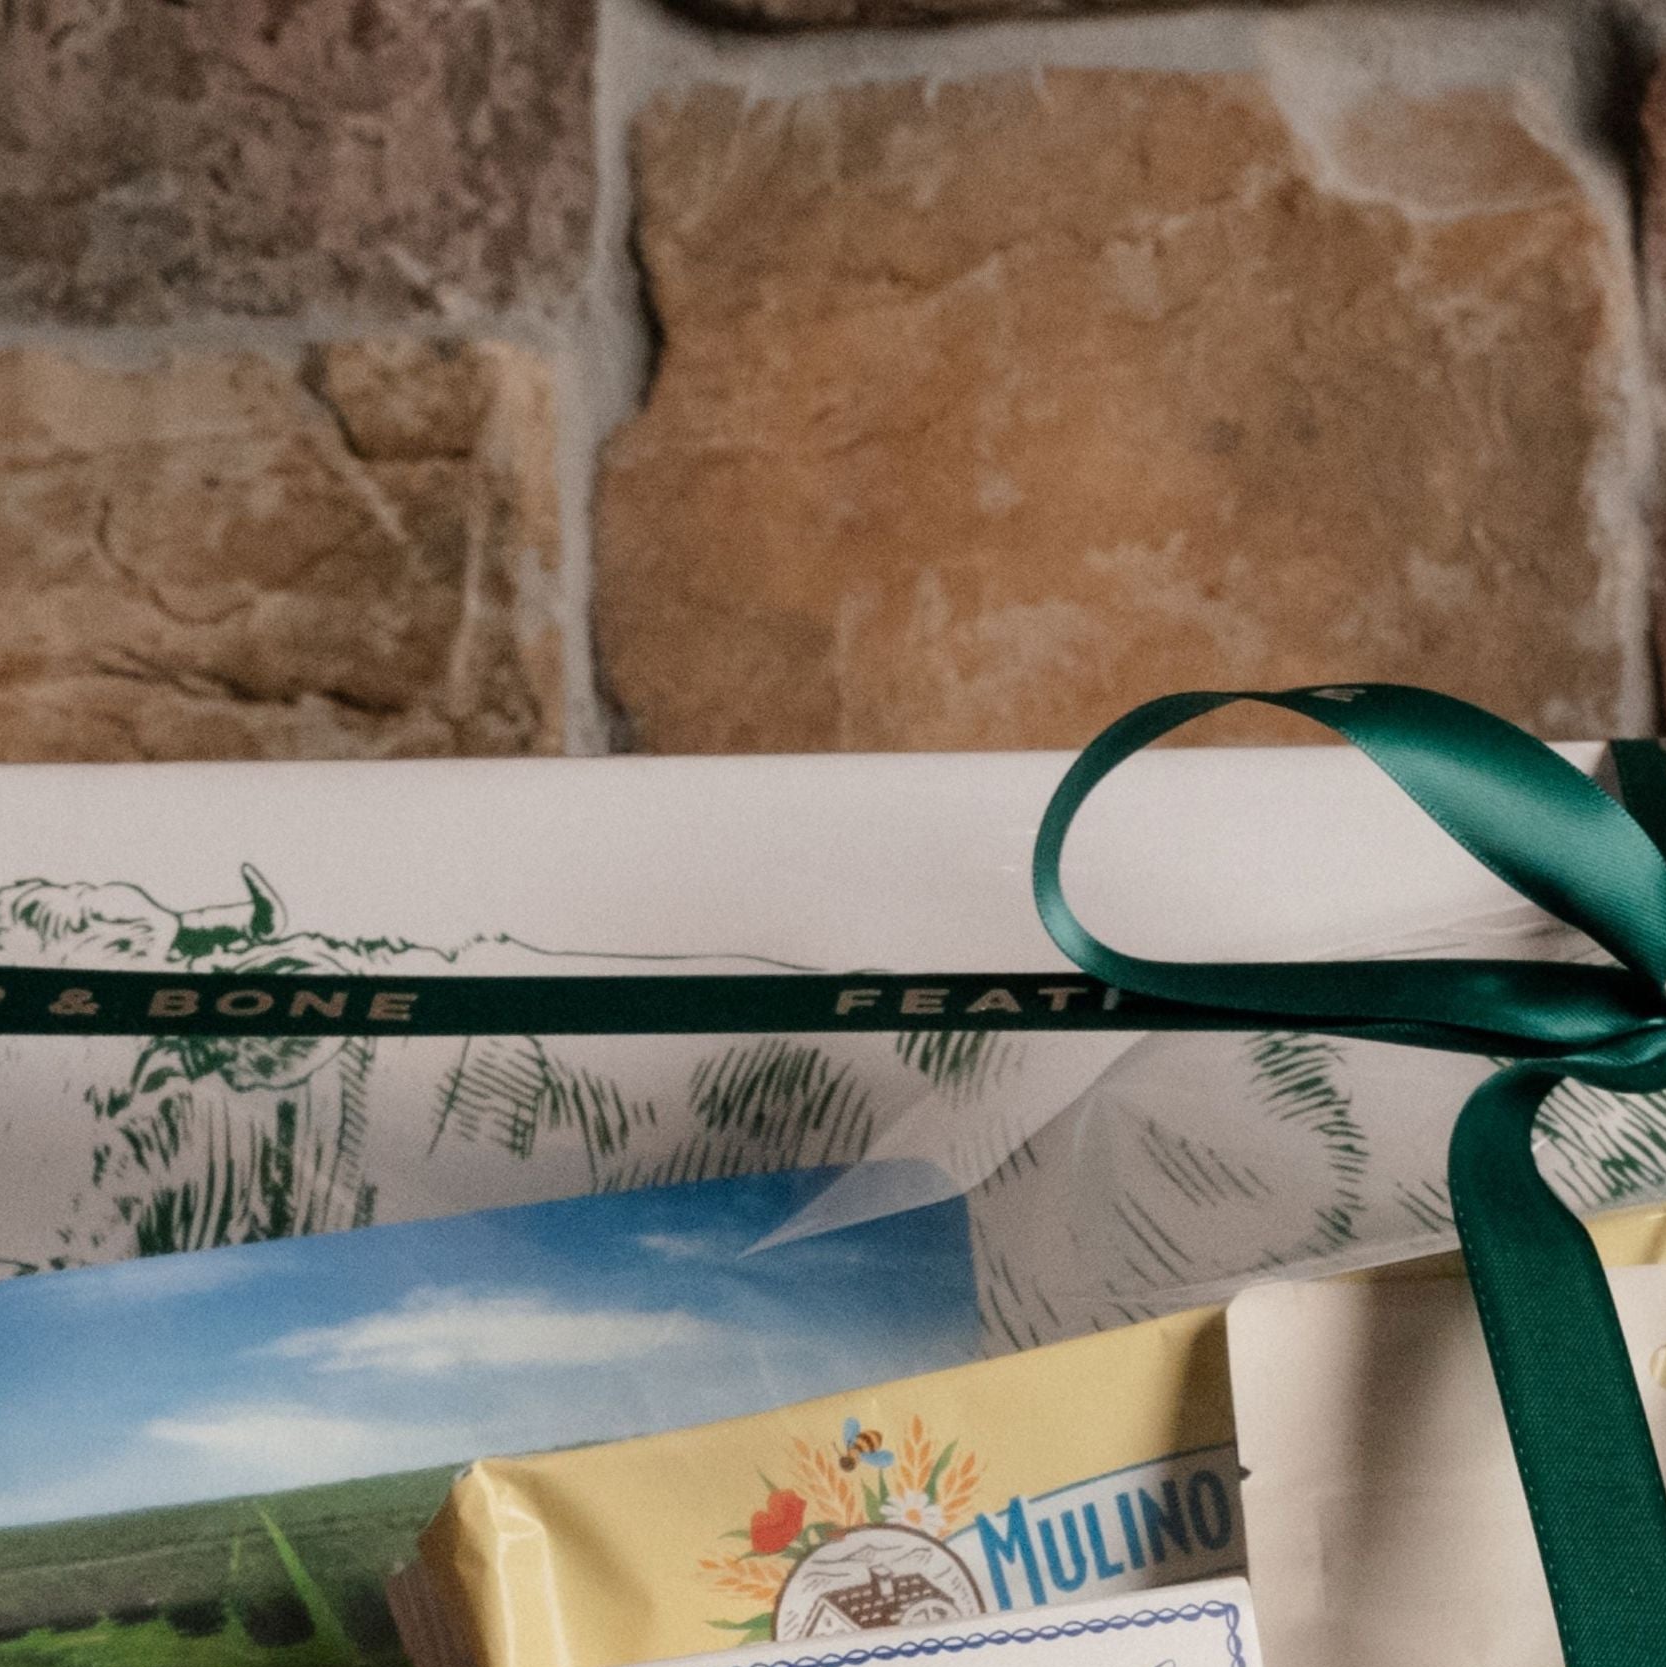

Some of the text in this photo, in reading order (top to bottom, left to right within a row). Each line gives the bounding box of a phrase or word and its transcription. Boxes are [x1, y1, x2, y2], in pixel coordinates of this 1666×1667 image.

[47, 989, 101, 1017] &
[145, 984, 419, 1022] BONE
[832, 984, 1120, 1017] FEAT
[973, 1467, 1234, 1611] MULINO
